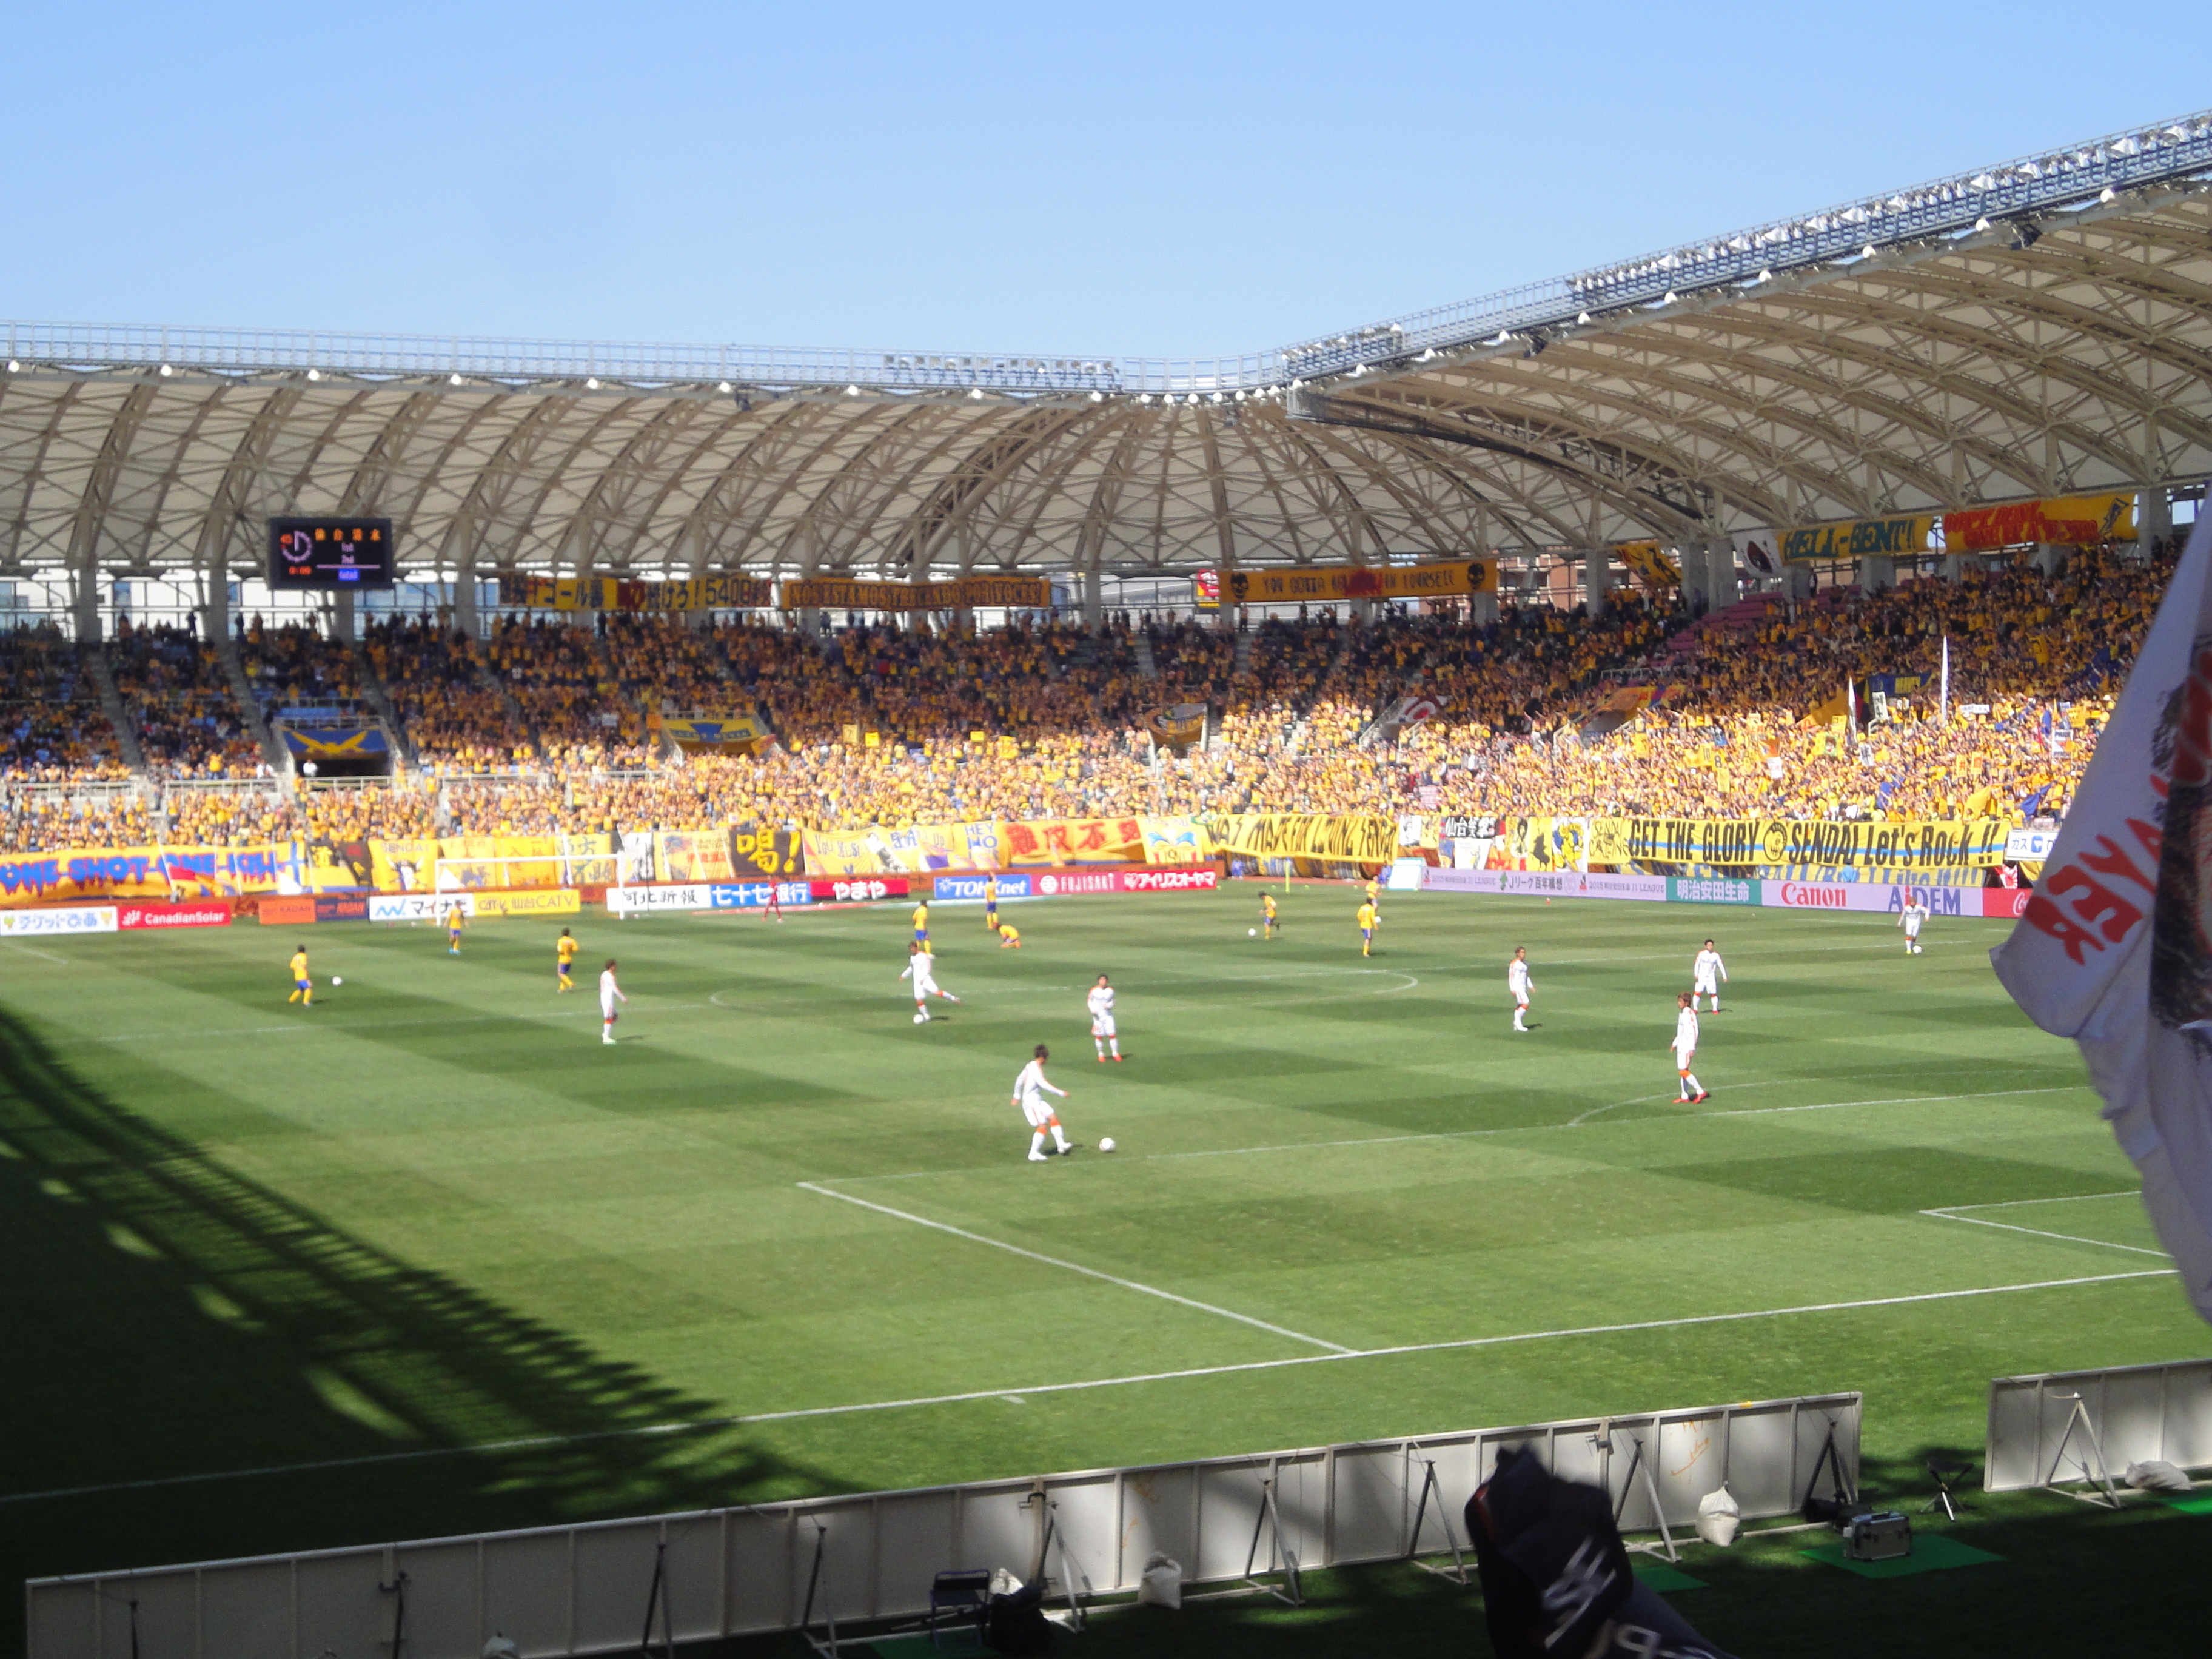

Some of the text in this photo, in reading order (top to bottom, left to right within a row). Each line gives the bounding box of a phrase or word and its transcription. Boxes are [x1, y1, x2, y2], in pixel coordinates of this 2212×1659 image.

[965, 822, 994, 836] HEY
[1629, 819, 1660, 857] GET
[1666, 820, 1695, 860] THE
[1702, 819, 1761, 862] GLORY
[1789, 822, 1860, 864] SENDAI
[1864, 824, 1915, 866] Let's
[1919, 823, 1974, 866] Rock
[69, 856, 149, 891] SHOT
[1138, 871, 1216, 889] アイリスオーヤマ
[622, 888, 698, 906] 河北新報
[712, 882, 808, 905] 七十七銀行
[832, 880, 887, 900] やまや
[1640, 884, 1664, 893] LEAGUE
[1677, 880, 1750, 902] 明治安田生命
[1781, 883, 1847, 907] Canon
[19, 912, 98, 930] チケットぴあ
